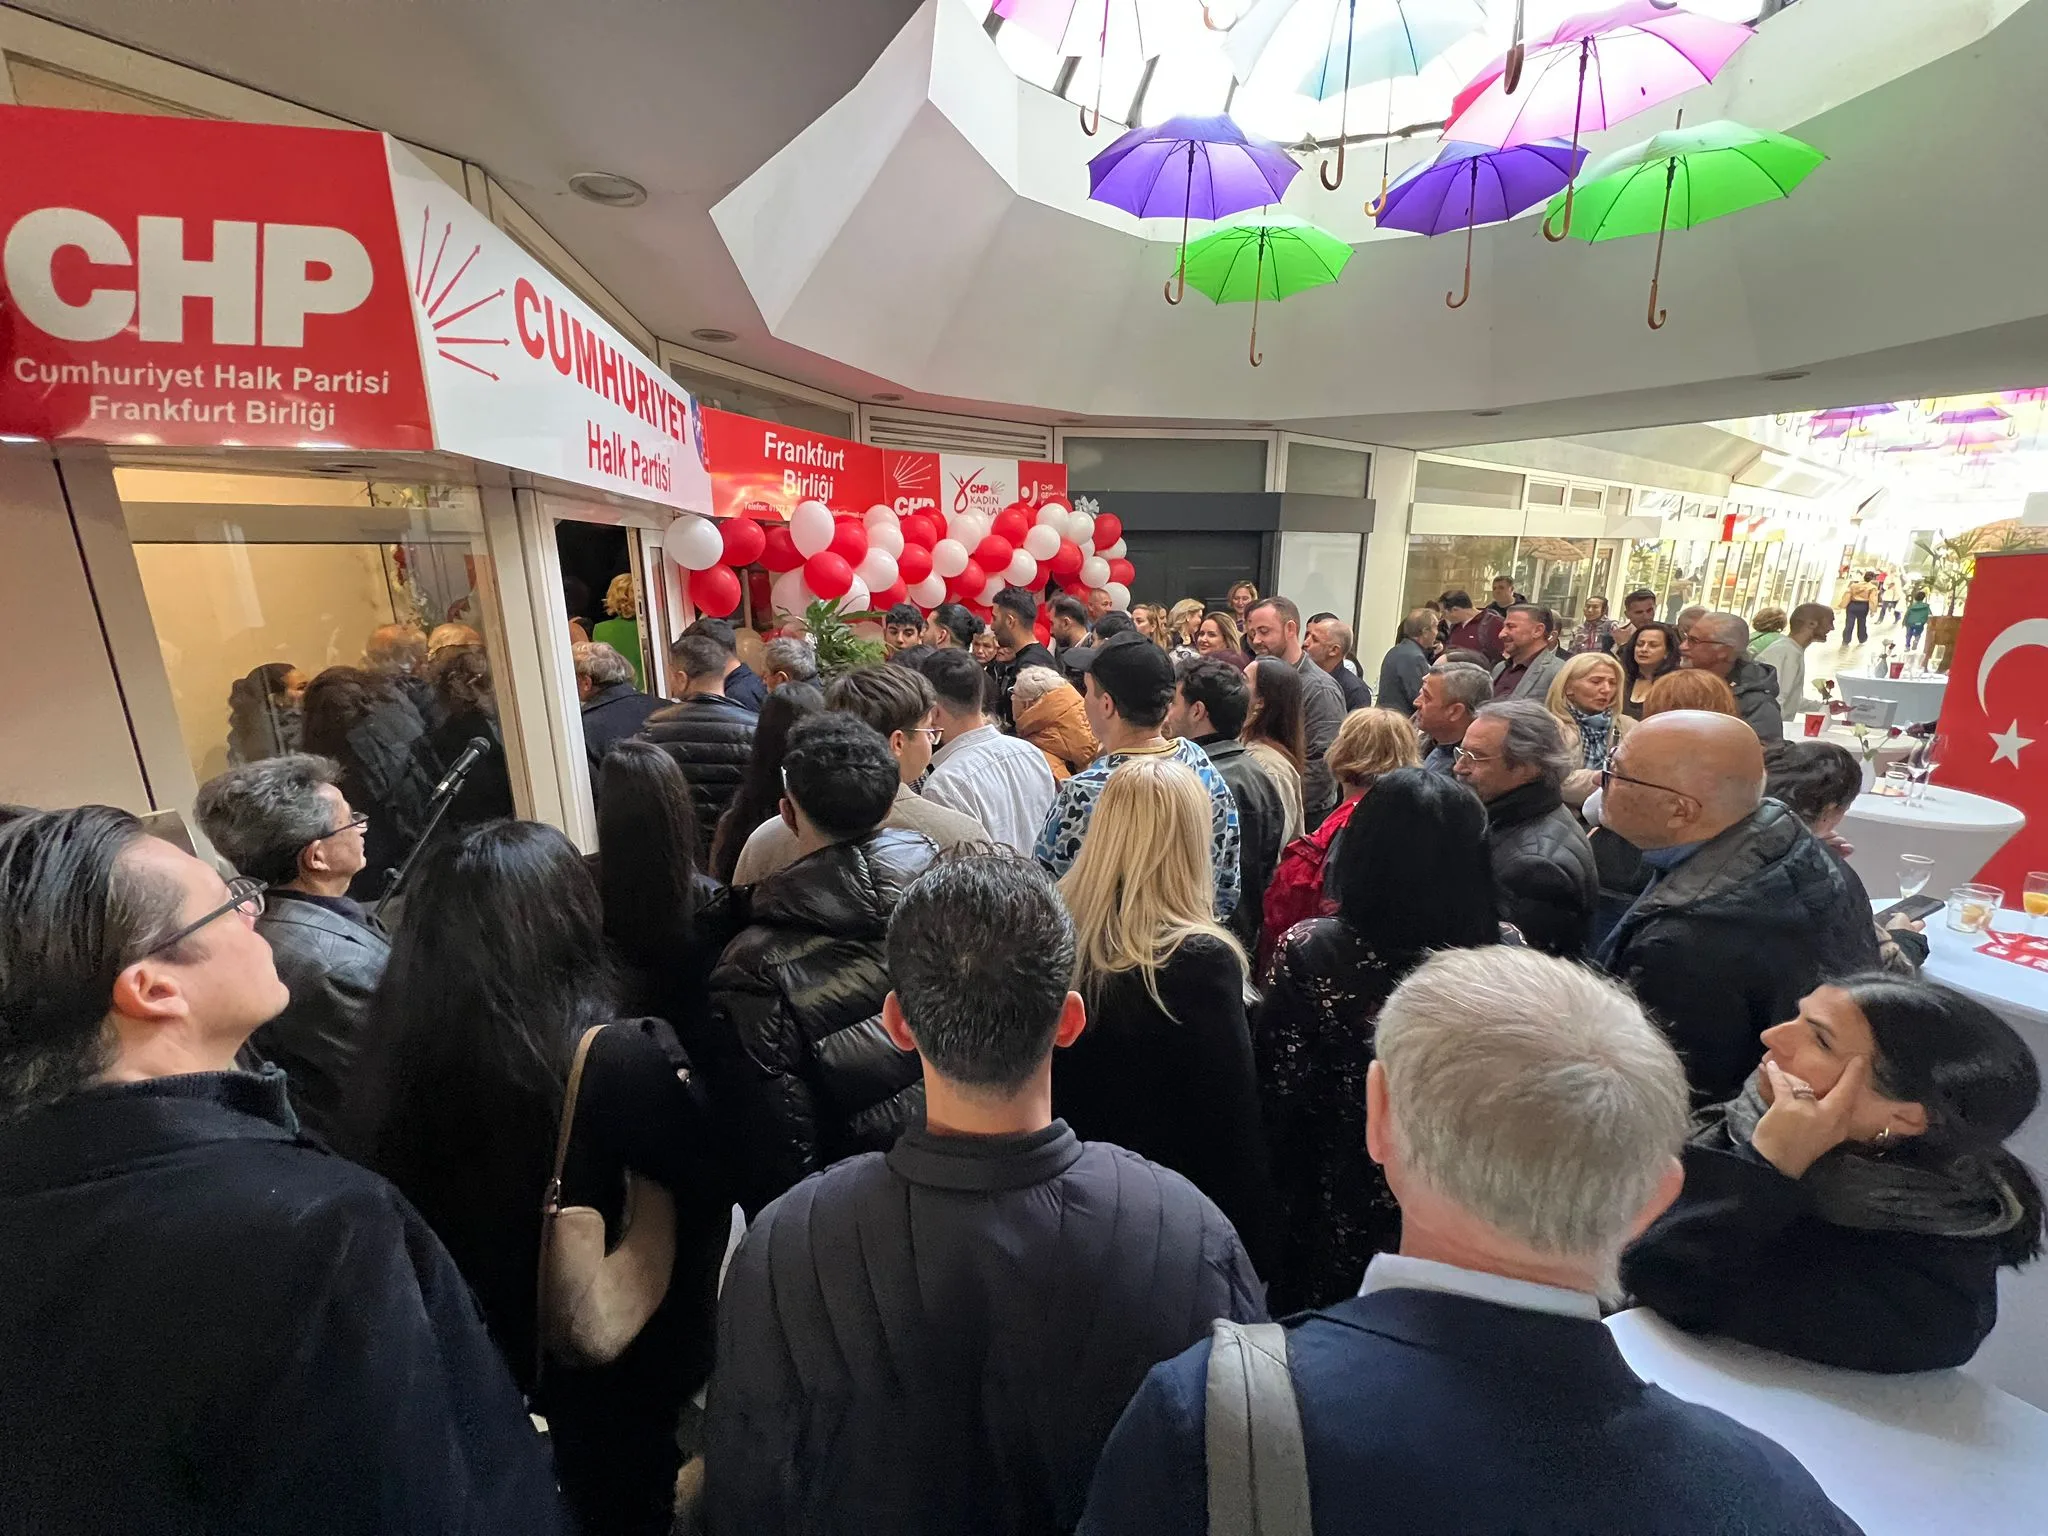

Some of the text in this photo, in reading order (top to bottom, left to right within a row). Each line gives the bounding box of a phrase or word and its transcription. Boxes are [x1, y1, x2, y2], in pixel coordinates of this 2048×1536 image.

[4, 207, 374, 348] CHP
[14, 358, 390, 394] Cumhuriyet Halk Partisi
[514, 277, 686, 445] CUMHURIYET
[90, 395, 236, 423] Frankfurt
[587, 419, 627, 479] Halk
[631, 440, 671, 493] Partisi
[764, 431, 845, 471] Frankfurt
[970, 483, 989, 494] CHP
[970, 495, 999, 505] KADIN
